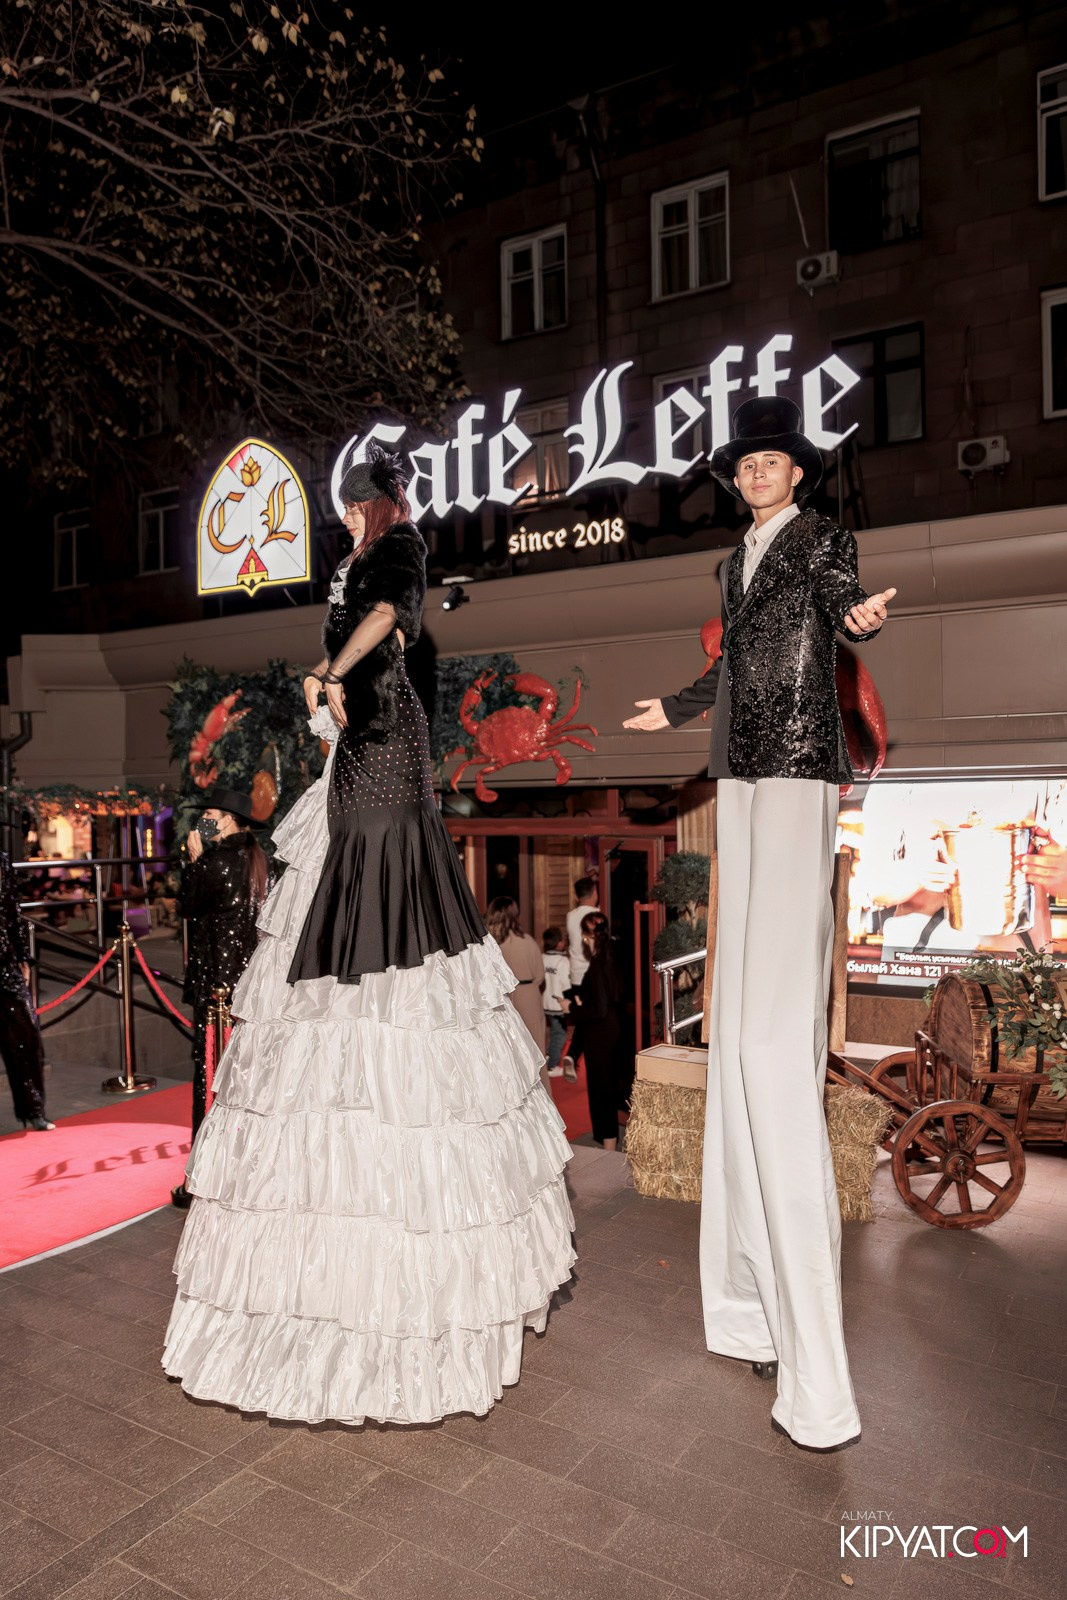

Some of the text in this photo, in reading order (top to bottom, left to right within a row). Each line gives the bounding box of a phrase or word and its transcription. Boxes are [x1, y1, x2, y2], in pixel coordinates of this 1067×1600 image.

[331, 334, 861, 523] Café Leffe
[508, 517, 625, 555] since 2018
[890, 964, 922, 976] Хана
[923, 965, 942, 977] 121
